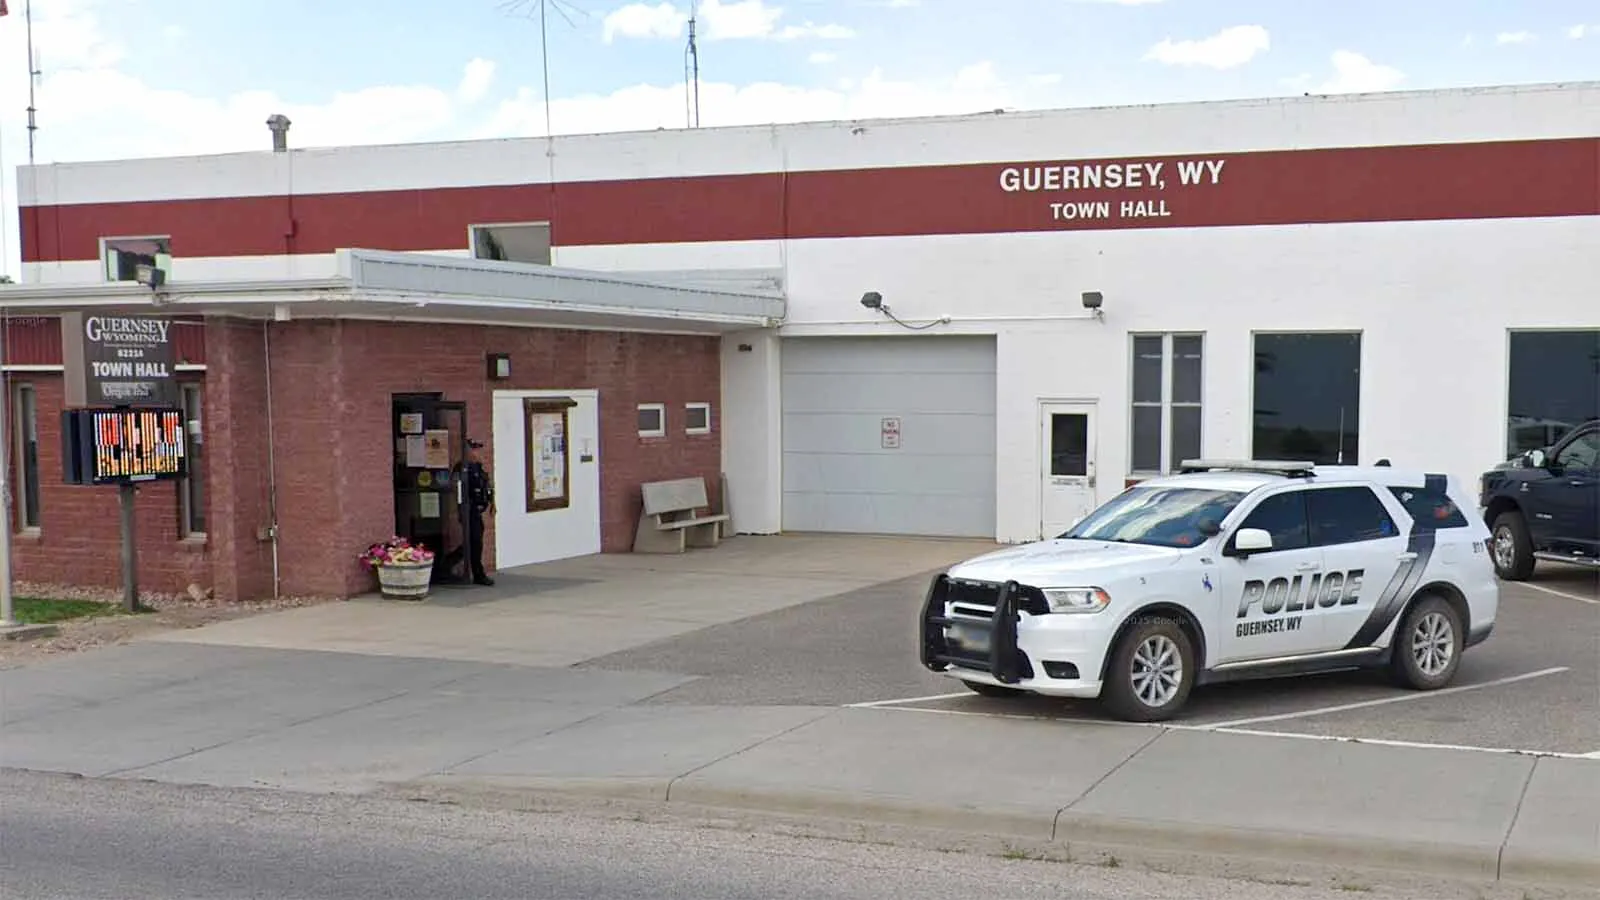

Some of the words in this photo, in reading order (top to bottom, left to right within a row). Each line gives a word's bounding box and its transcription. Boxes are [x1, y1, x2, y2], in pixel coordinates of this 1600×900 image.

[1000, 162, 1165, 192] GUERNSEY,
[1177, 160, 1225, 185] WY
[1050, 202, 1109, 220] TOWN
[1120, 200, 1171, 217] HALL
[86, 317, 170, 343] GUERNSEY
[102, 333, 160, 343] WYOMING
[92, 361, 133, 377] TOWN
[135, 362, 169, 377] HALL
[1236, 568, 1365, 618] POLICE
[1286, 616, 1302, 630] WY
